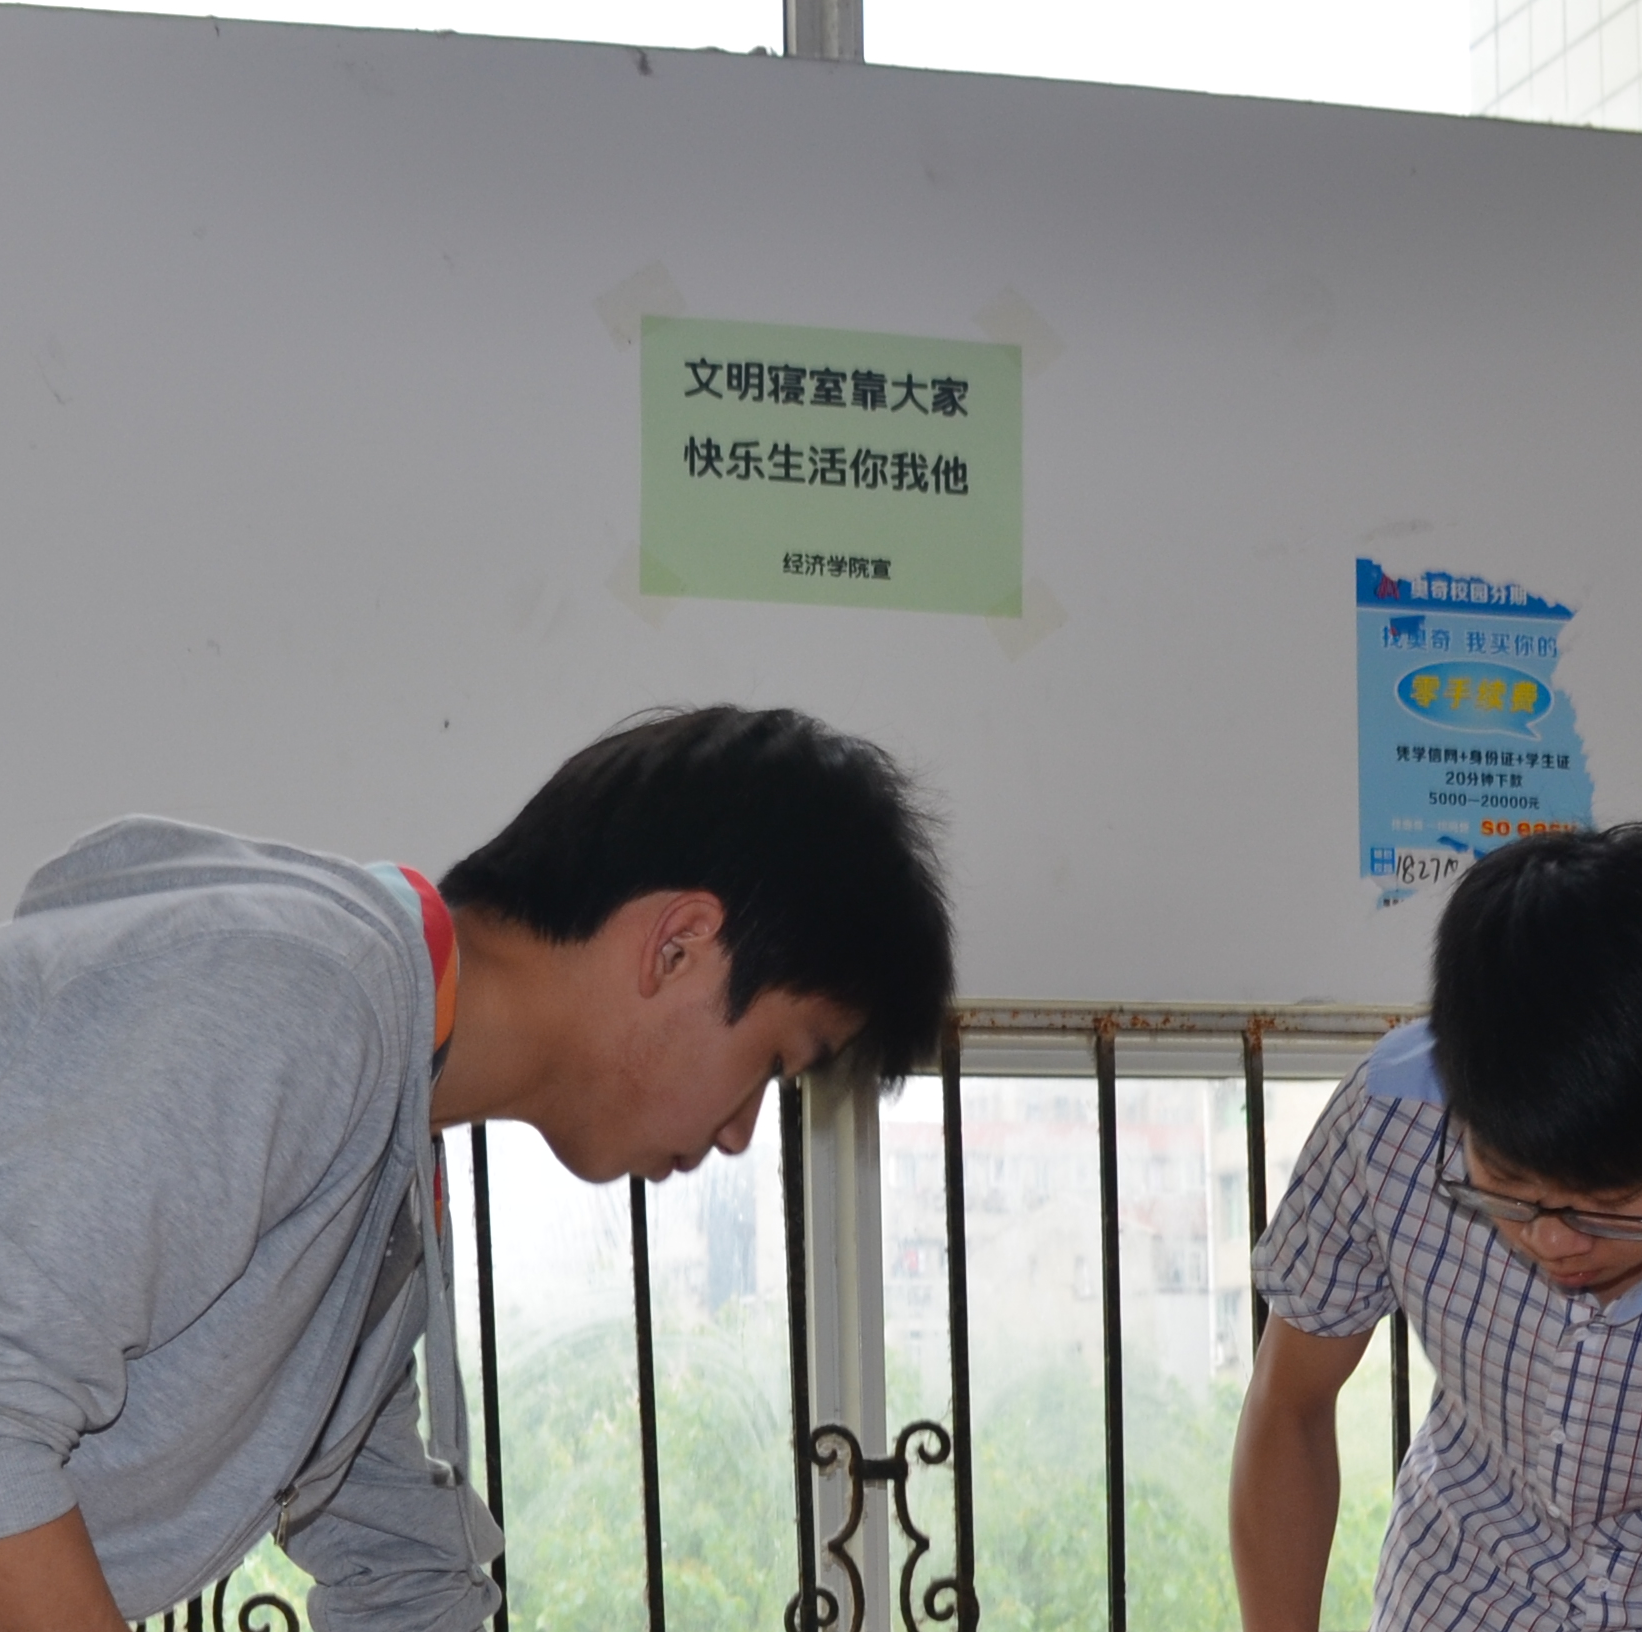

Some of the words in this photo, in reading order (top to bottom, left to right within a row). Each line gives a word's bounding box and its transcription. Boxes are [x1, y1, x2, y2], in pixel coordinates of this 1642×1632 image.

[684, 357, 969, 417] 文明寝室靠大家
[683, 435, 969, 496] 快乐生活你我他
[783, 552, 892, 580] 经济学院宣
[1410, 675, 1539, 714] 零手续费
[1395, 745, 1571, 771] 凭学信网+身份证+学生证
[1445, 771, 1524, 789] 20分钟下款
